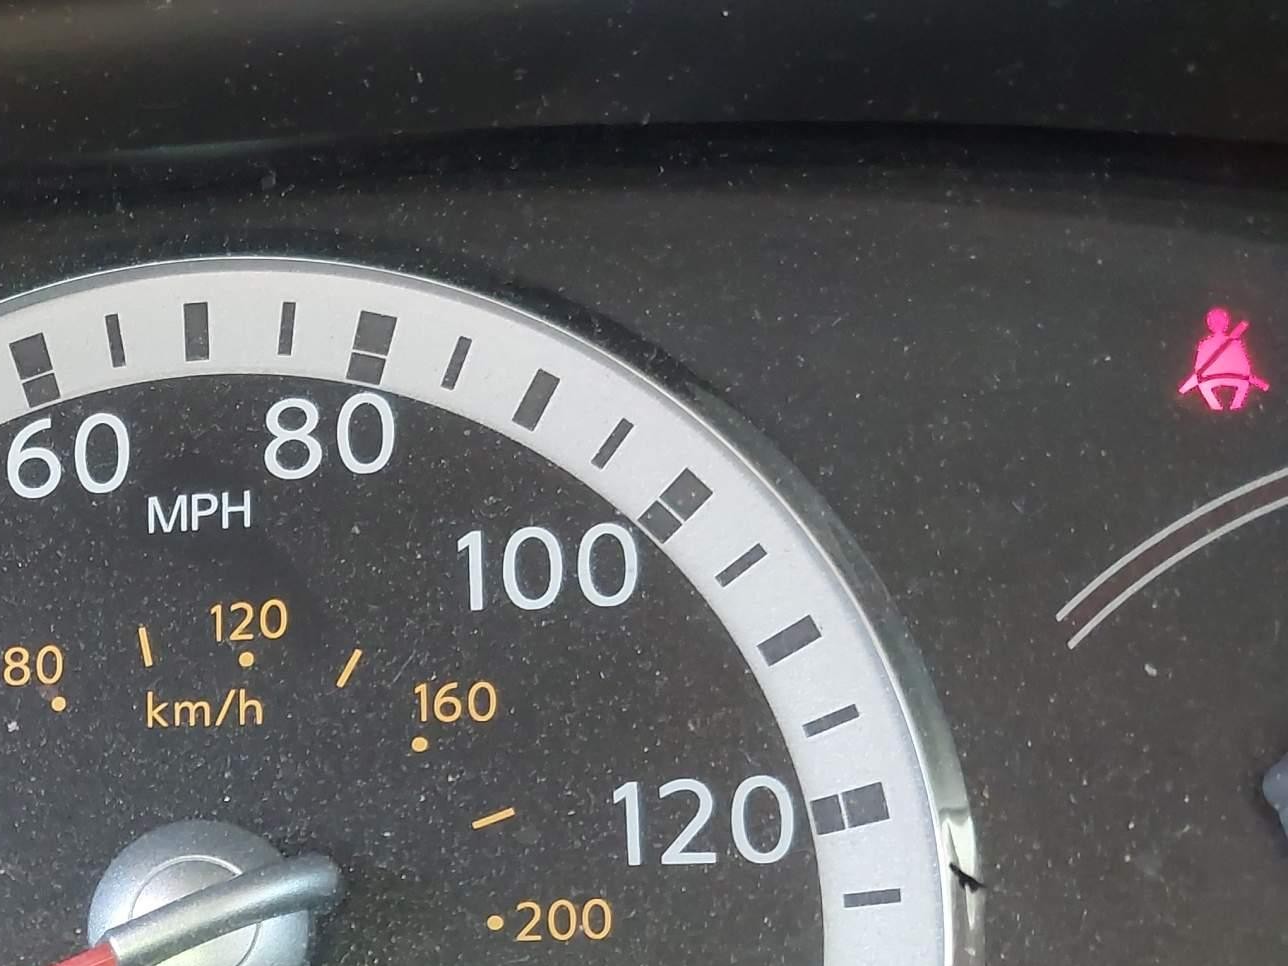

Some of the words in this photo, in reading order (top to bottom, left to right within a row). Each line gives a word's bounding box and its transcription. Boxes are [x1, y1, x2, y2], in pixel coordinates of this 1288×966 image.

[6, 411, 130, 499] 60
[264, 392, 396, 481] 80
[147, 490, 252, 535] MPH
[456, 522, 639, 612] 100
[210, 599, 289, 643] 120
[2, 644, 65, 686] 80
[145, 687, 264, 729] km/h
[413, 680, 498, 724] 160
[612, 775, 794, 867] 120
[515, 898, 613, 943] 200
